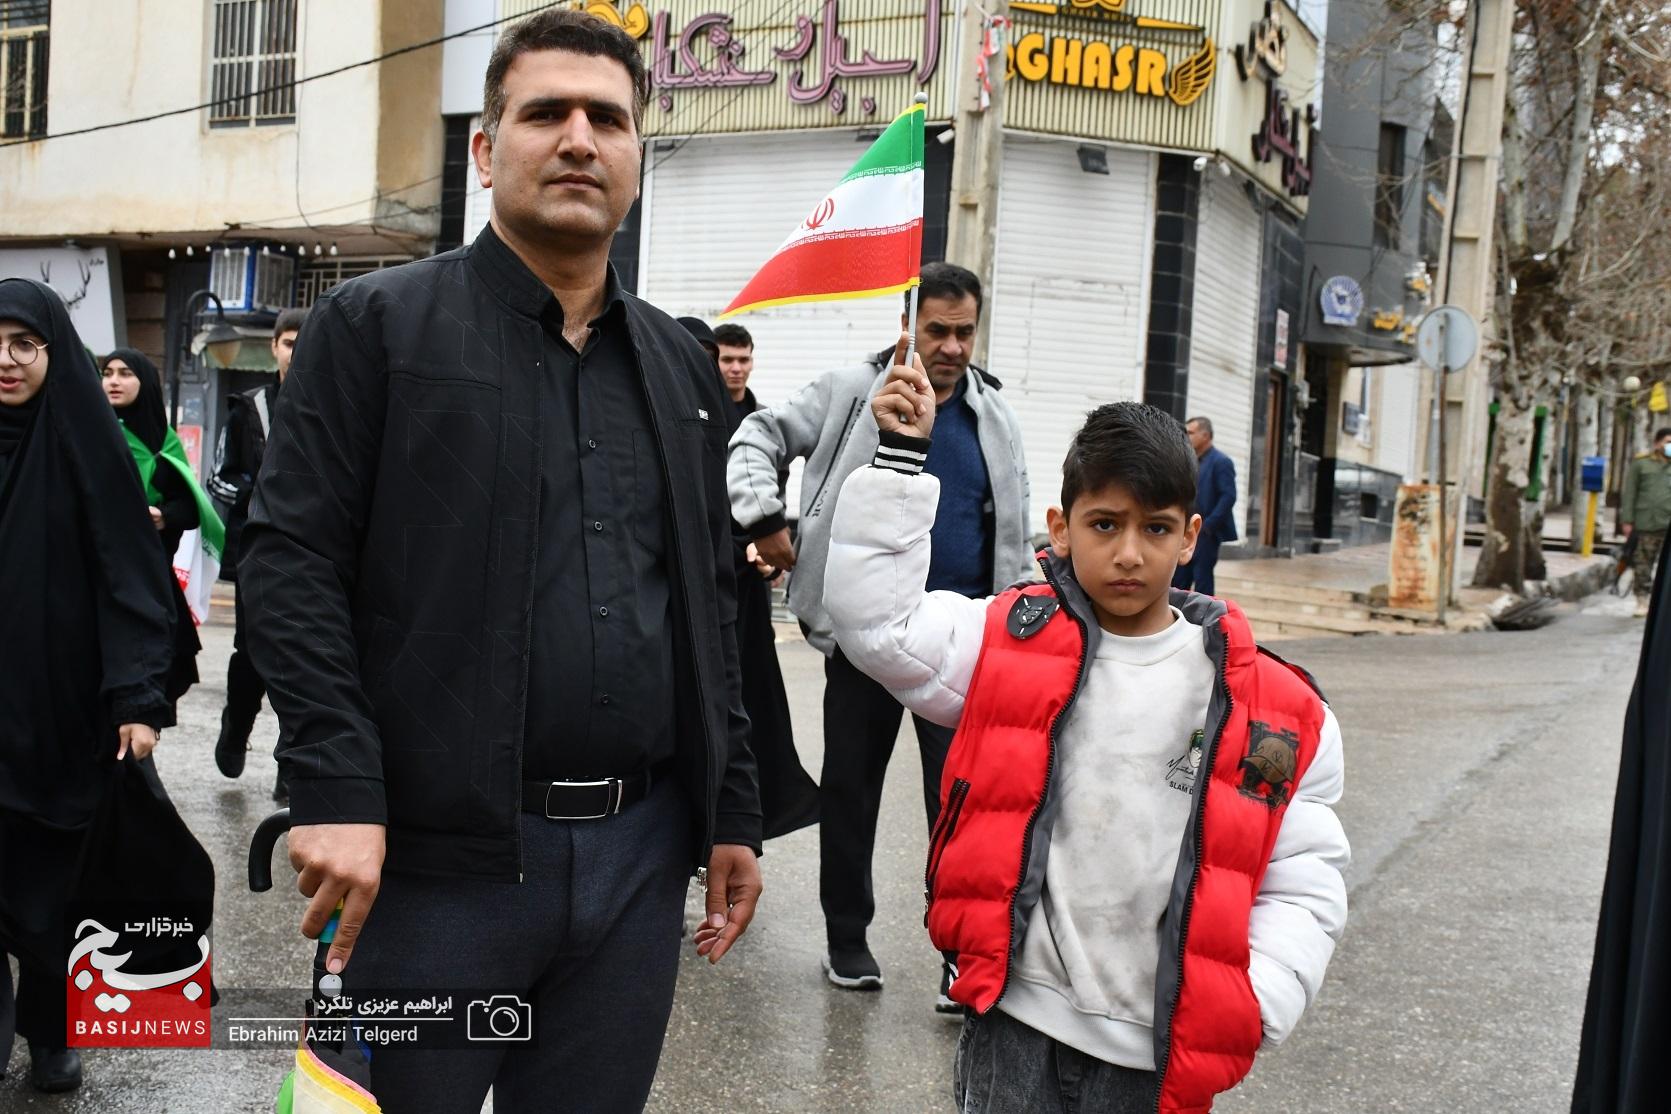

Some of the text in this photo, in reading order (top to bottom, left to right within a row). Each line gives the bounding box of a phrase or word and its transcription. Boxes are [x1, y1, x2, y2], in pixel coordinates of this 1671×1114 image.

[644, 9, 779, 112] خشکبا
[1016, 32, 1166, 96] GHASR
[1169, 780, 1188, 794] SLAM
